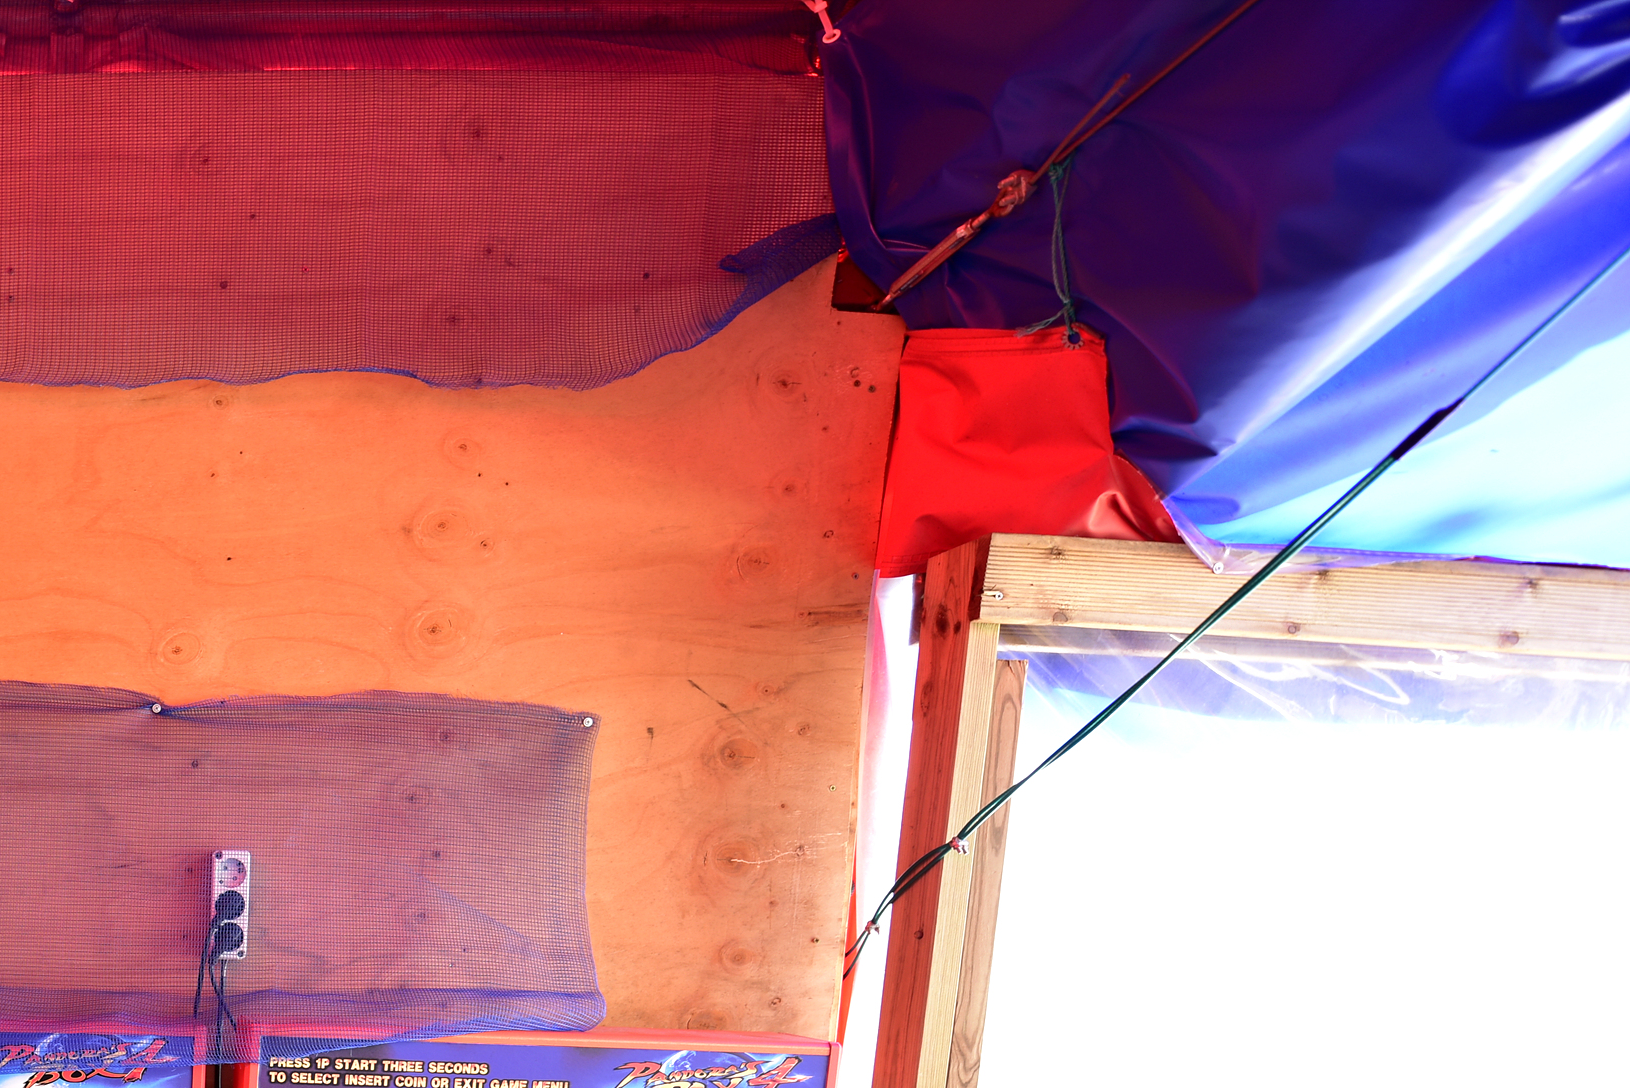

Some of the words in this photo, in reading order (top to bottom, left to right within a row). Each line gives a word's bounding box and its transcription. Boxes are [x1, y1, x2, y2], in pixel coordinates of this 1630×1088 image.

[270, 1057, 311, 1069] PRESS
[315, 1058, 330, 1070] 1P
[334, 1059, 377, 1071] START
[382, 1060, 423, 1072] THREE
[428, 1061, 489, 1075] SECONDS
[269, 1071, 287, 1083] TO
[291, 1072, 340, 1085] SELECT
[344, 1074, 390, 1087] INSERT
[395, 1075, 427, 1088] COIN
[431, 1077, 449, 1088] OR
